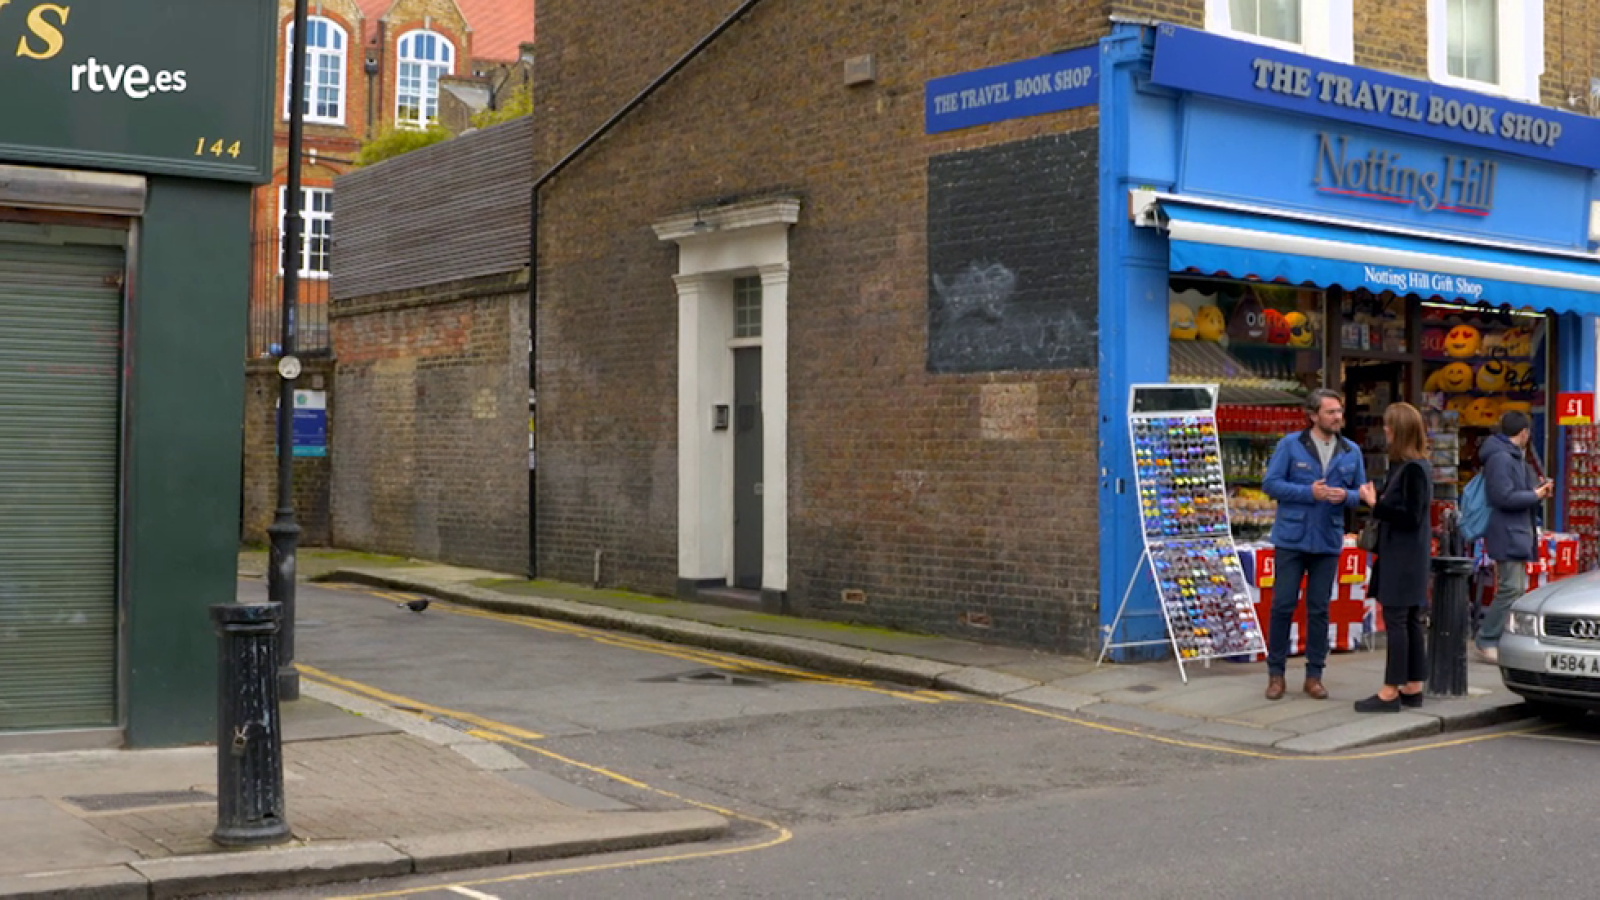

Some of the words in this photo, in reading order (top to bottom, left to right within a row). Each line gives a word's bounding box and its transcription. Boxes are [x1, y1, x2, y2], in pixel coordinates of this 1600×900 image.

[934, 92, 958, 114] THE
[960, 82, 1010, 110] TRAVEL
[1014, 73, 1052, 99] BOOK
[1054, 66, 1092, 91] SHOP
[1253, 58, 1312, 98] THE
[1316, 72, 1423, 121] TRAVEL
[1427, 96, 1496, 134] BOOK
[1500, 112, 1563, 147] SHOP
[194, 137, 241, 158] 144
[1312, 131, 1438, 211] Notting
[1440, 154, 1498, 210] Hill
[1364, 265, 1407, 291] Notting
[1409, 271, 1430, 290] Hill
[1431, 274, 1453, 292] Gift
[1456, 277, 1483, 299] Shop
[1566, 399, 1583, 418] £1
[1346, 554, 1359, 576] £1
[1550, 654, 1586, 671] W584
